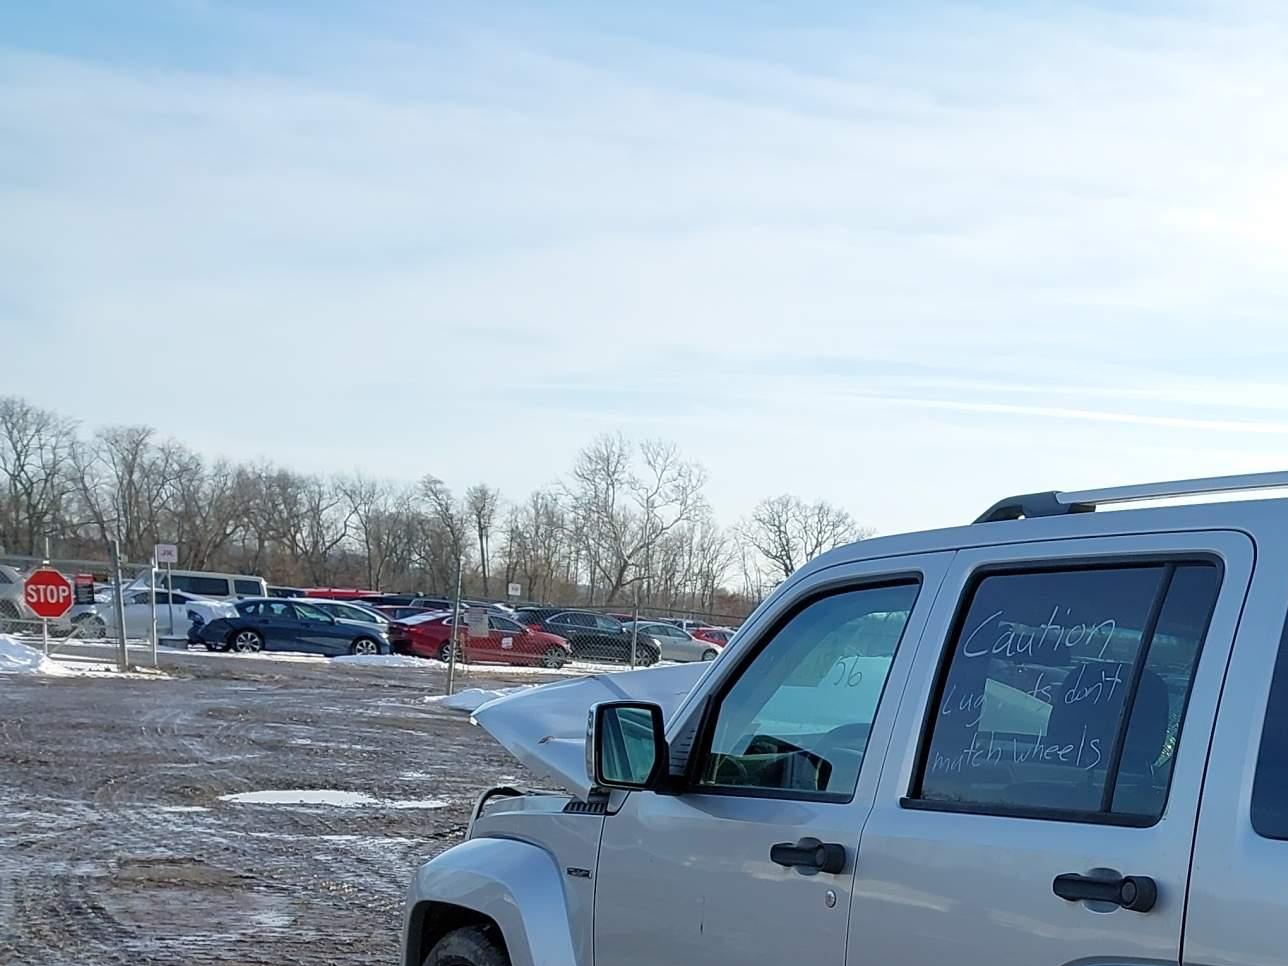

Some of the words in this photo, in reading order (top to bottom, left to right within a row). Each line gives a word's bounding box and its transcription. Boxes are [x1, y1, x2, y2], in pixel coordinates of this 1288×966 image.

[27, 585, 69, 603] STOP
[964, 606, 1115, 658] Caution
[1064, 663, 1122, 705] don't
[931, 730, 1001, 773] match
